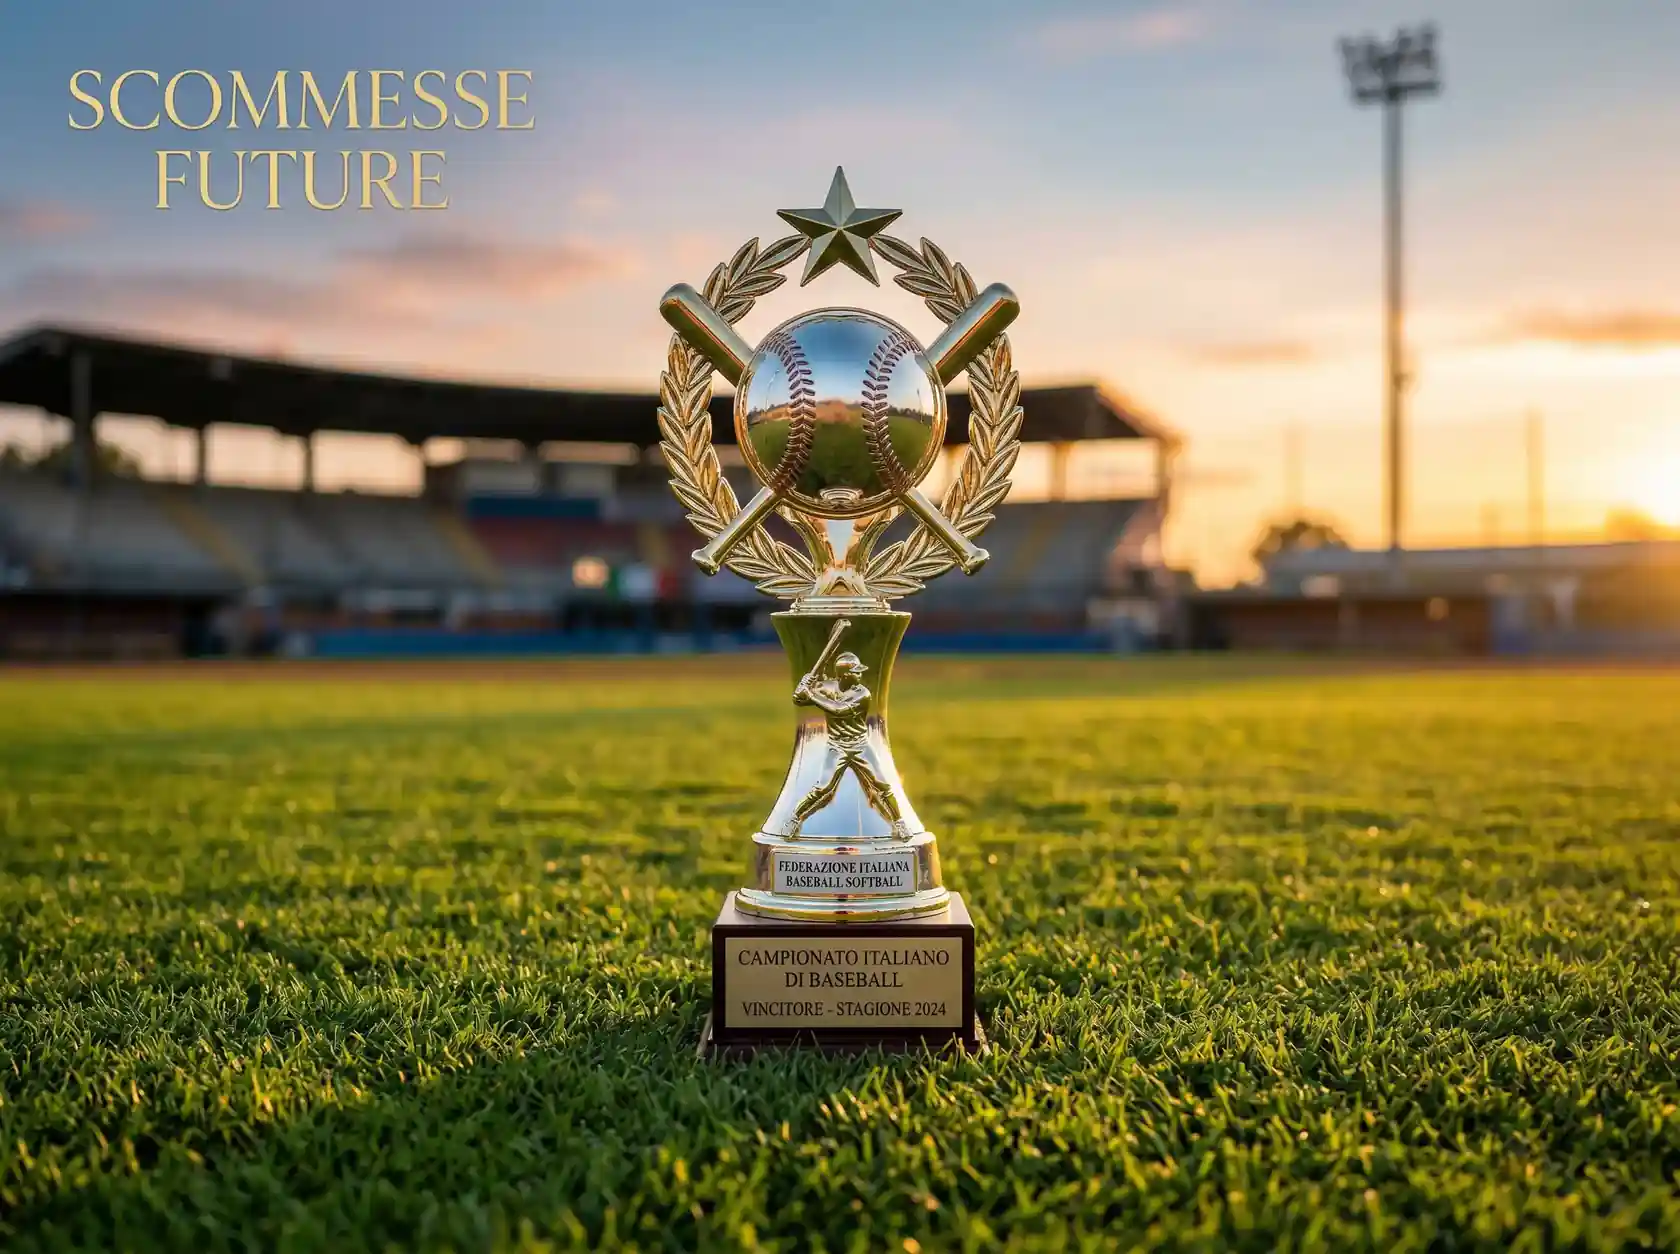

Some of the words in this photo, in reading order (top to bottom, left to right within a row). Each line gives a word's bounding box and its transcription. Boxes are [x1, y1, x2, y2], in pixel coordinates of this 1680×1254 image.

[779, 860, 856, 873] FEDERAZIONE
[859, 860, 910, 873] ITALIANA
[786, 876, 844, 888] BASEBALL
[845, 876, 903, 888] SOFTBALL
[738, 949, 858, 966] CAMPIONATO
[863, 949, 950, 966] ITALIANO
[785, 972, 804, 988] DI
[809, 972, 903, 988] BASEBALL
[742, 1001, 823, 1017] VINCITORE
[836, 1001, 911, 1017] STAGIONE
[914, 1001, 946, 1017] 2024
